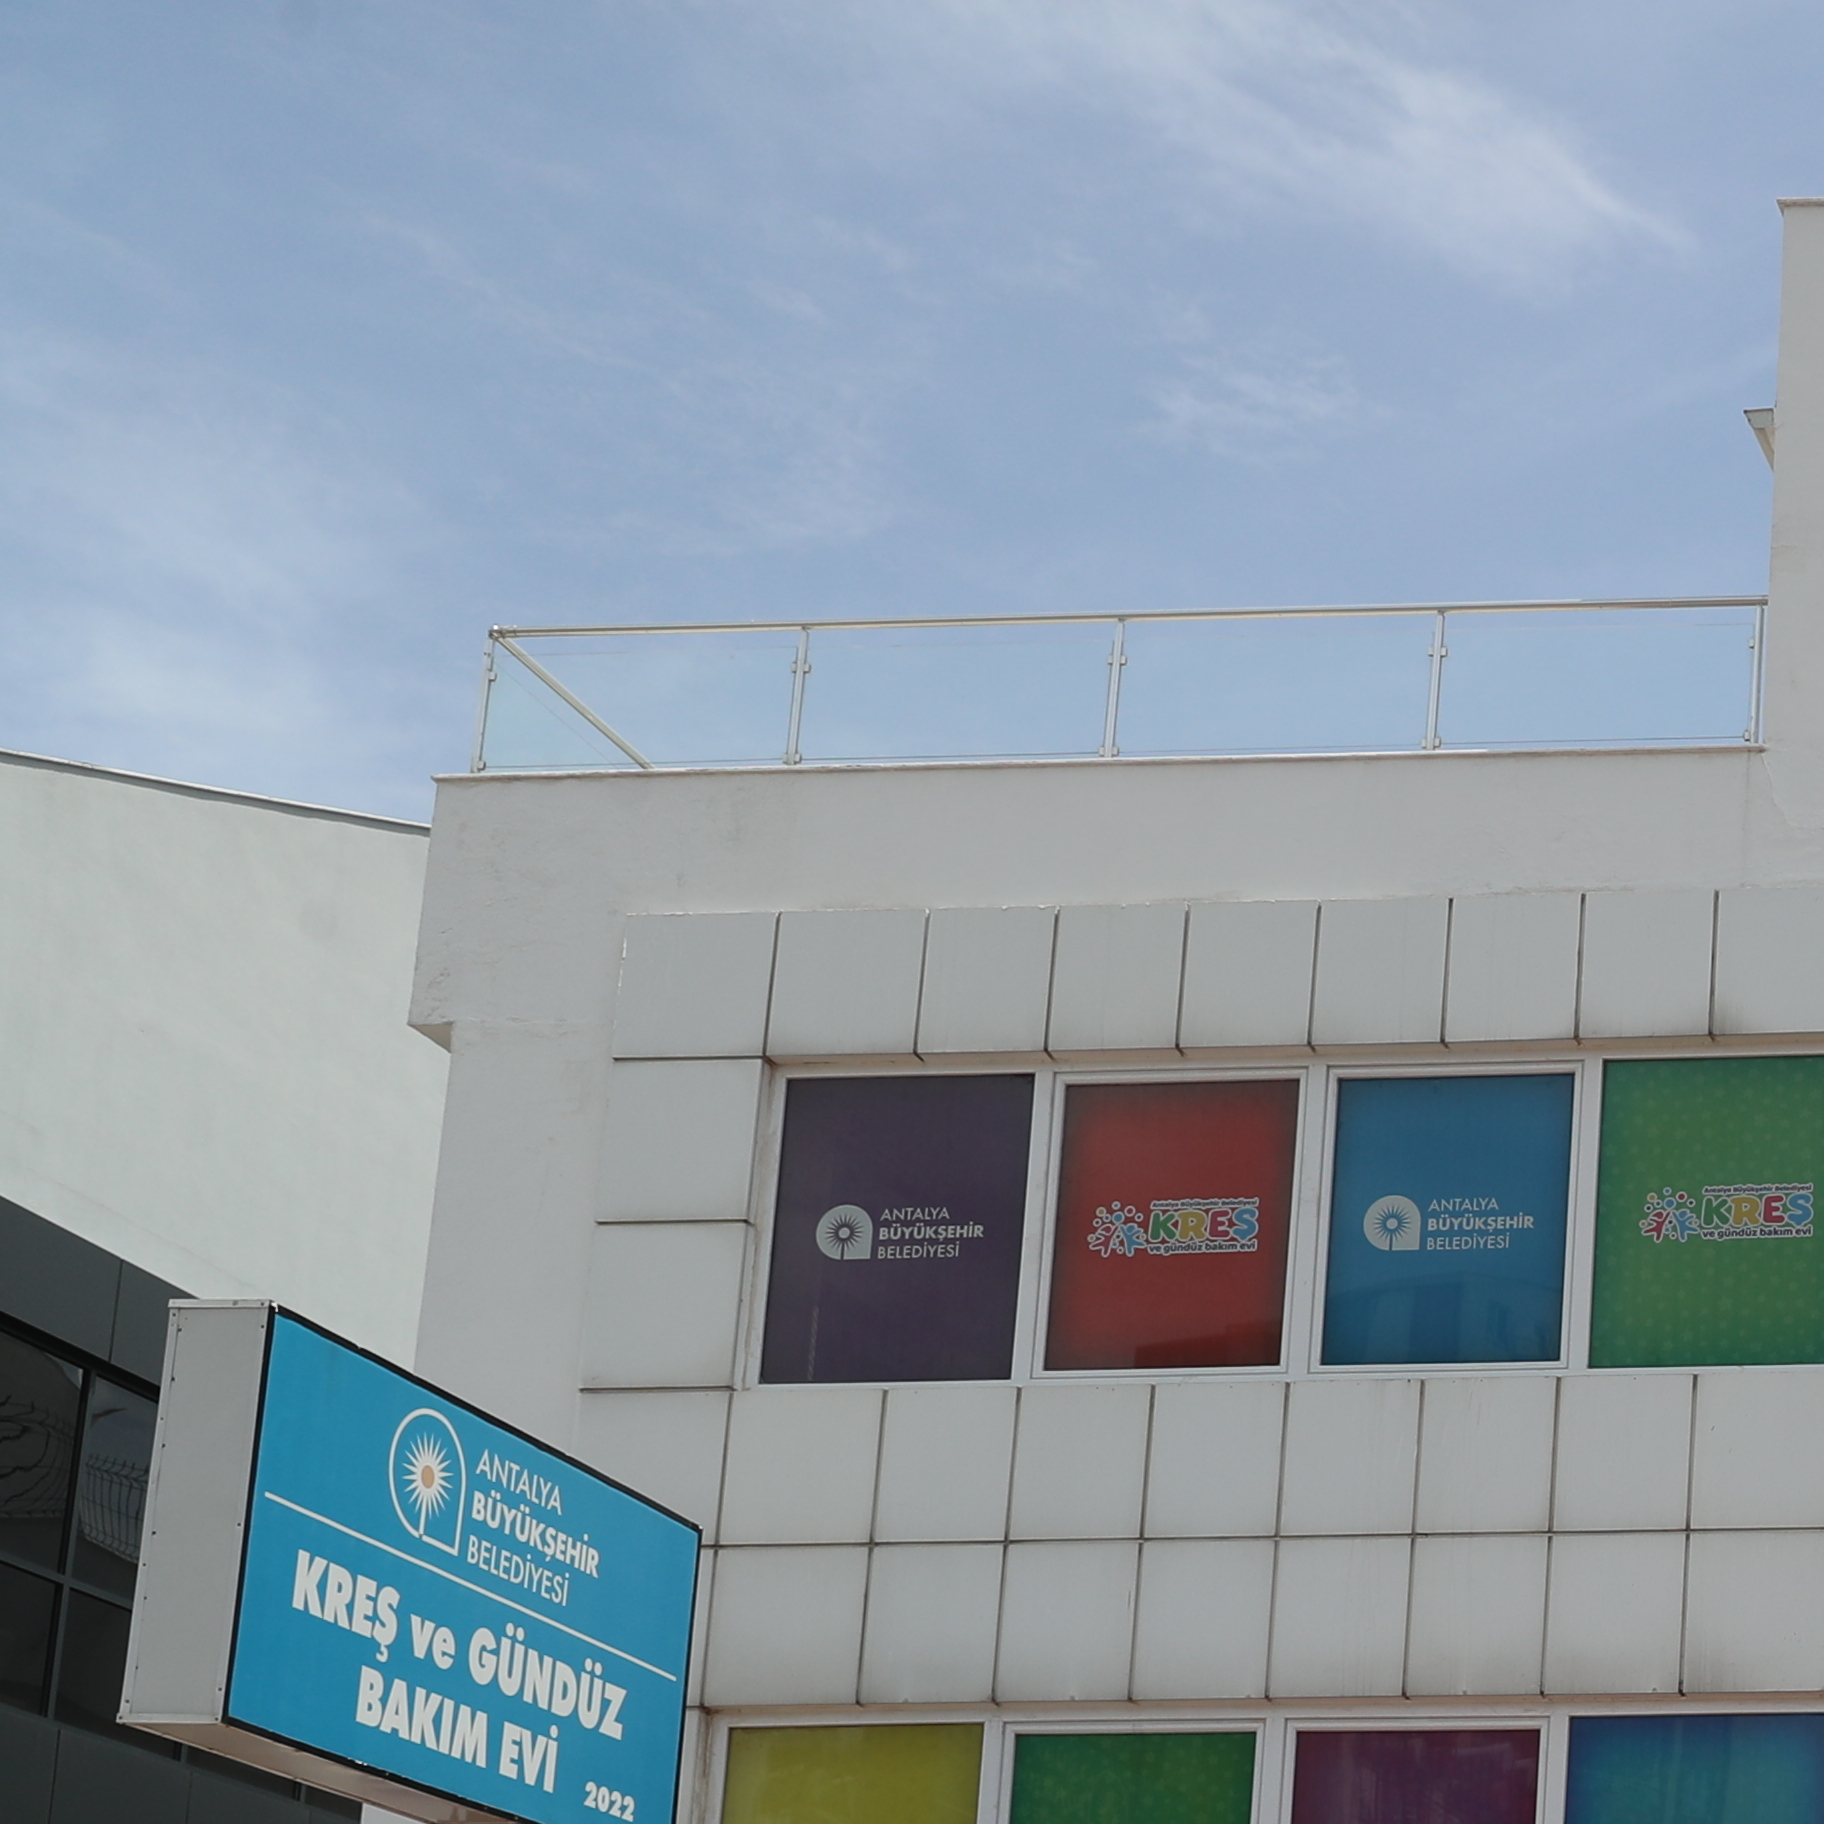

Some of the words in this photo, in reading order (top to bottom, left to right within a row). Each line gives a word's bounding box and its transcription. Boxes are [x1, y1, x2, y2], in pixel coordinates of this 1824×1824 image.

[880, 1207, 950, 1221] ANTALYA
[1428, 1198, 1498, 1211] ANTALYA
[1702, 1194, 1813, 1226] KREŞ
[879, 1221, 984, 1241] BÜYÜKŞEHİR
[1150, 1208, 1258, 1241] KREŞ
[1428, 1212, 1534, 1232] BÜYÜKŞEHİR
[1702, 1230, 1715, 1238] ve
[1717, 1228, 1757, 1239] gündüz
[1760, 1227, 1792, 1236] bakım
[1795, 1226, 1811, 1235] evi
[878, 1241, 959, 1259] BELEDİYESİ
[1150, 1244, 1161, 1252] ve
[1163, 1243, 1202, 1253] gündüz
[1205, 1242, 1237, 1250] bakım
[1240, 1241, 1255, 1250] evi
[1427, 1232, 1509, 1250] BELEDİYESİ
[476, 1449, 562, 1515] ANTALYA
[472, 1491, 599, 1578] BÜYÜKŞEHİR
[468, 1539, 568, 1606] BELEDİYESİ
[292, 1549, 400, 1662] KREŞ
[410, 1614, 456, 1669] ve
[468, 1622, 628, 1740] GÜNDÜZ
[356, 1665, 488, 1768] BAKIM
[499, 1722, 558, 1793] EVİ
[584, 1782, 635, 1822] 2022
